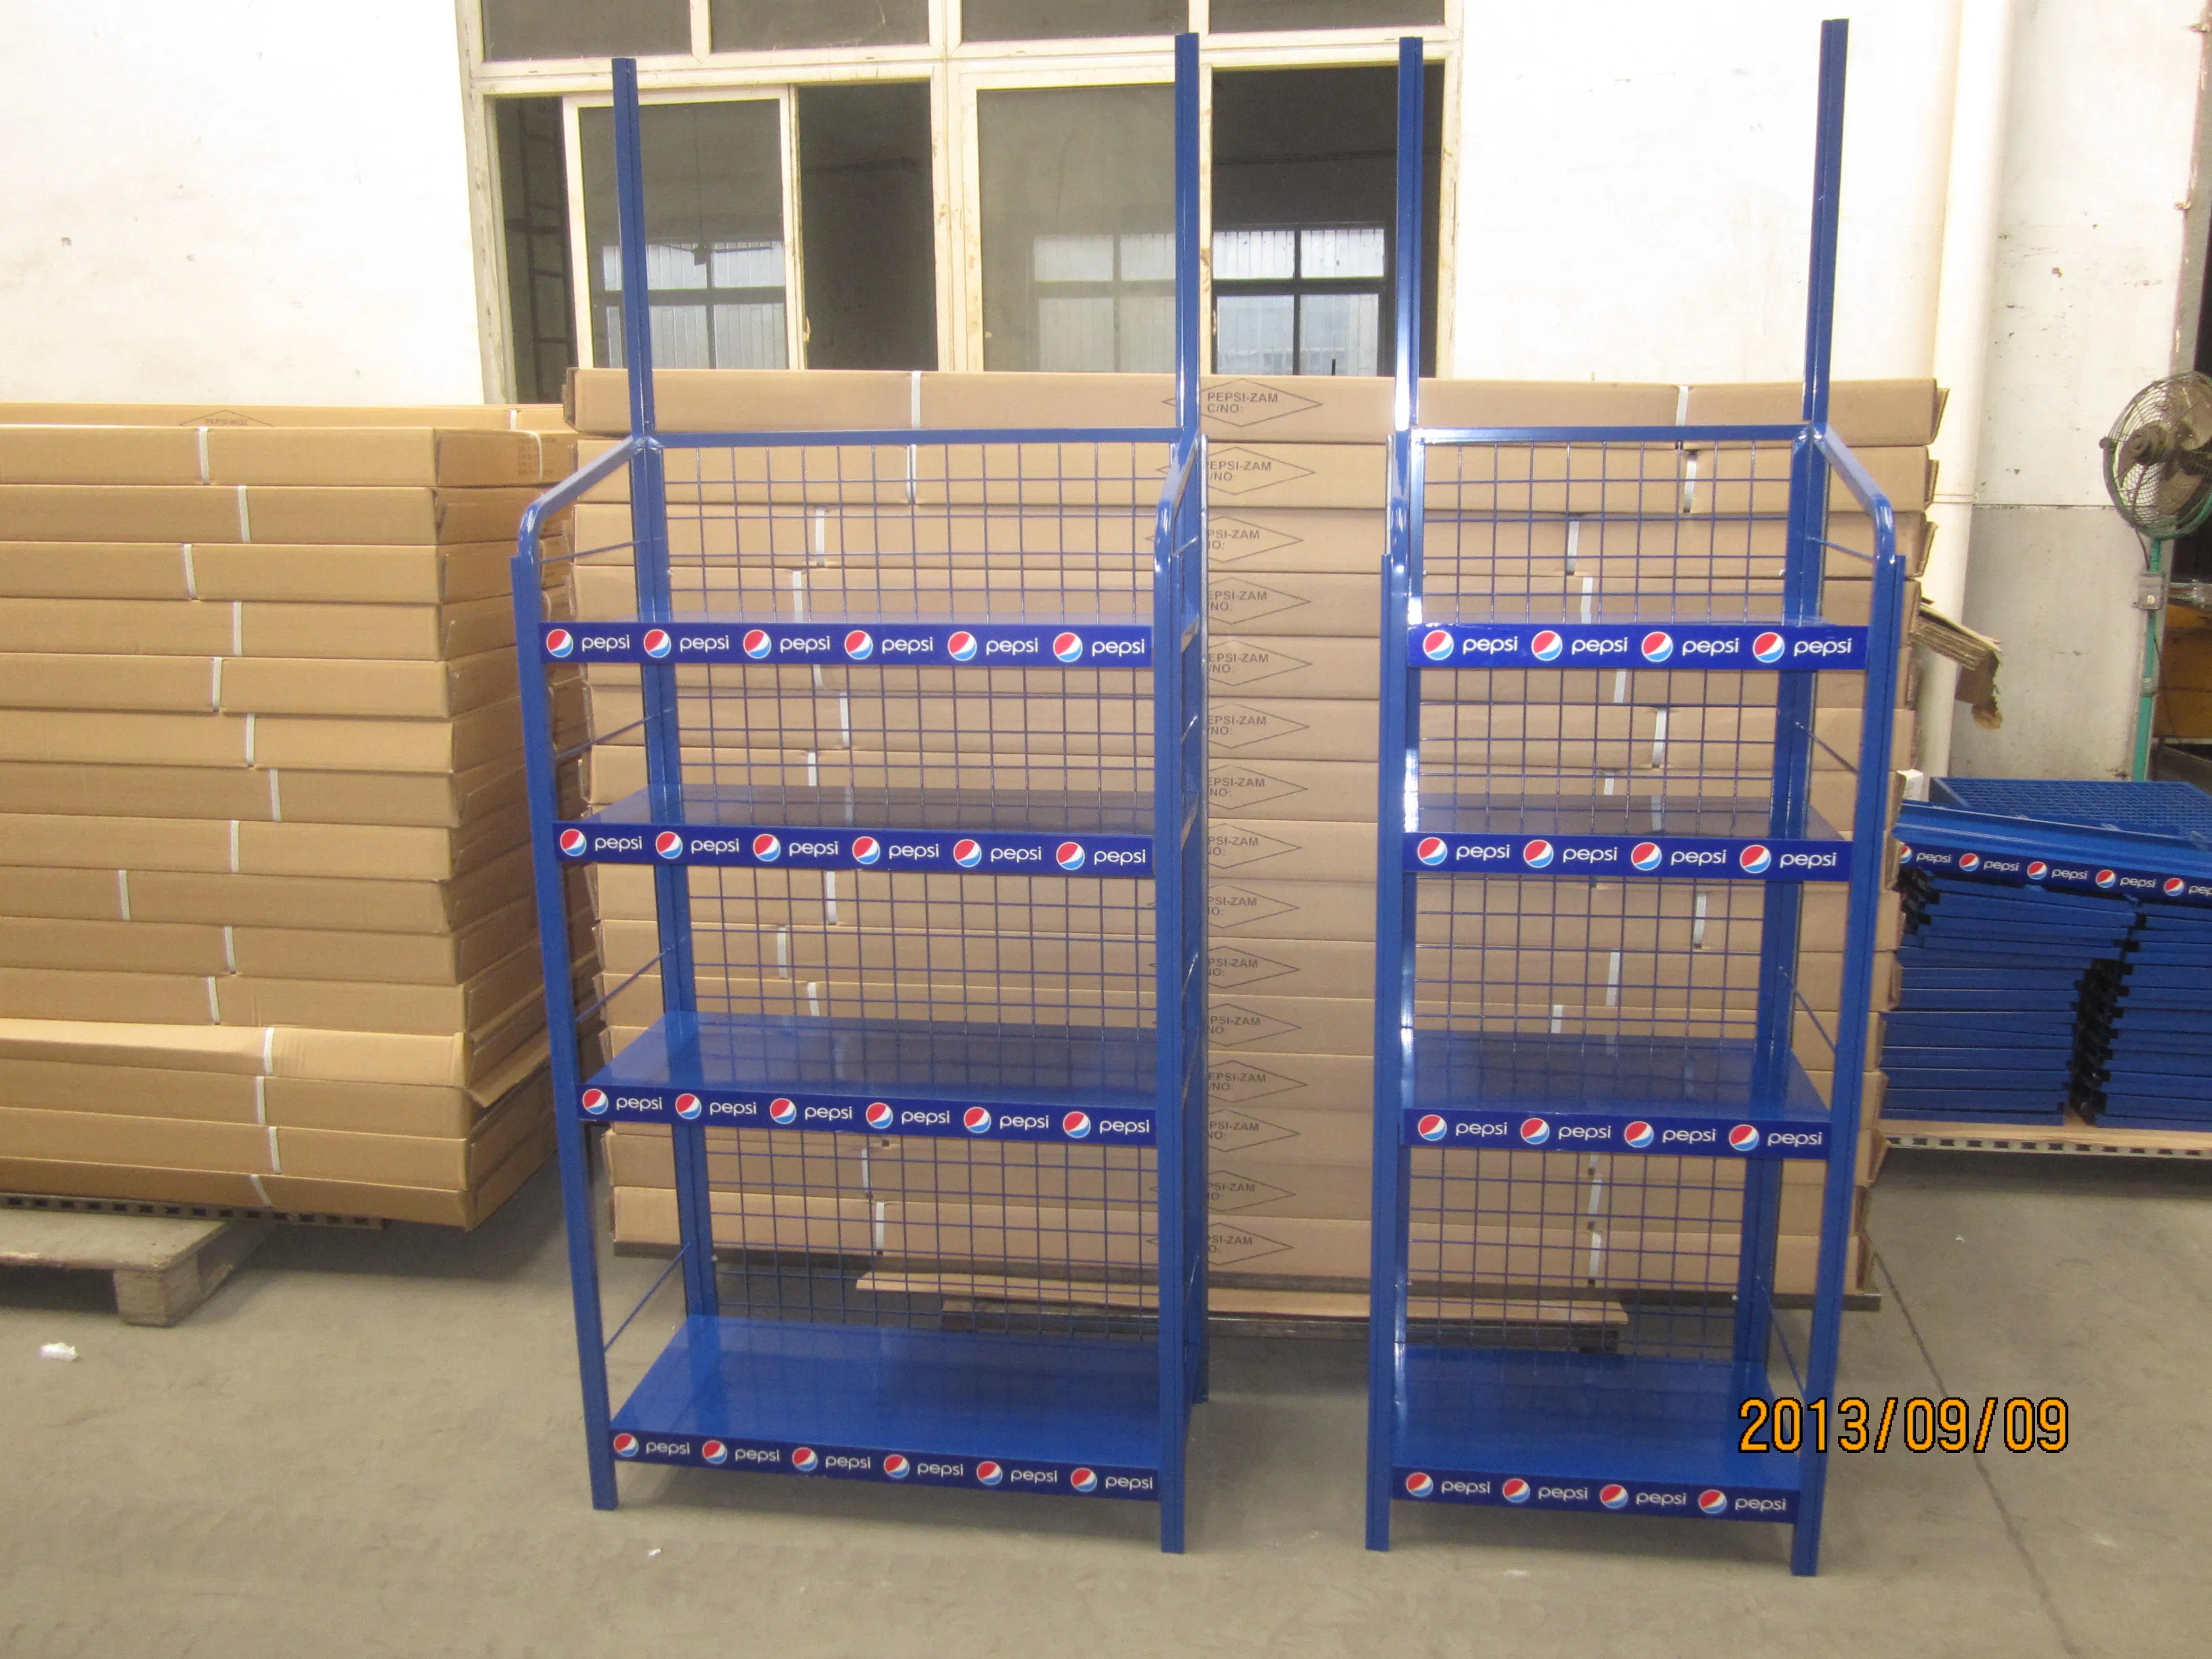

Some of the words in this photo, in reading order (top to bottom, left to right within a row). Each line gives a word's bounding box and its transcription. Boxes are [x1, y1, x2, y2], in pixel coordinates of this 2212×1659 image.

[1208, 392, 1278, 403] PEPSI-ZAM
[1207, 404, 1243, 413] C/NO:
[1208, 461, 1271, 471] EPSI-ZAM
[1210, 472, 1236, 481] /NO:
[1208, 530, 1260, 539] PSI-ZAM
[1208, 591, 1267, 600] EPSI-ZAM
[581, 634, 630, 652] pepsi
[679, 634, 729, 653] pepsi
[779, 635, 831, 654] pepsi
[882, 636, 933, 655] pepsi
[985, 637, 1039, 656] pepsi
[1091, 638, 1145, 657] pepsi
[1462, 636, 1518, 655] pepsi
[1571, 636, 1629, 655] pepsi
[1681, 637, 1740, 657] pepsi
[1793, 638, 1852, 657] pepsi
[1208, 653, 1269, 663] EPSI-ZAM
[1208, 716, 1267, 725] EPSI-ZAM
[1208, 778, 1265, 787] EPSI-ZAM
[1208, 837, 1258, 846] PSI-ZAM
[594, 836, 642, 853] pepsi
[691, 838, 740, 855] pepsi
[788, 840, 839, 857] pepsi
[888, 843, 939, 861] pepsi
[990, 846, 1042, 863] pepsi
[1094, 848, 1146, 866] pepsi
[1456, 844, 1511, 861] pepsi
[1562, 846, 1618, 864] pepsi
[1671, 849, 1727, 867] pepsi
[1780, 852, 1837, 869] pepsi
[1915, 852, 1952, 864] pepsi
[1983, 860, 2020, 872] pepsi
[2051, 869, 2088, 880] pepsi
[2119, 877, 2156, 888] pepsi
[2188, 885, 2212, 897] pep
[1208, 897, 1257, 905] PSI-ZAM
[1208, 958, 1258, 968] PSI-ZAM
[1210, 1016, 1261, 1025] PSI-ZAM
[1209, 1073, 1266, 1082] EPSI-ZAM
[616, 1097, 663, 1112] pepsi
[710, 1101, 757, 1117] pepsi
[804, 1106, 853, 1122] pepsi
[901, 1110, 950, 1126] pepsi
[999, 1115, 1049, 1131] pepsi
[1099, 1119, 1150, 1135] pepsi
[1210, 1121, 1259, 1131] PSI-ZAM
[1455, 1122, 1508, 1137] pepsi
[1558, 1125, 1612, 1141] pepsi
[1662, 1128, 1717, 1145] pepsi
[1767, 1132, 1822, 1147] pepsi
[645, 1441, 691, 1456] pepsi
[735, 1448, 780, 1463] pepsi
[825, 1456, 871, 1471] pepsi
[917, 1462, 964, 1477] pepsi
[1010, 1469, 1058, 1484] pepsi
[1105, 1476, 1153, 1491] pepsi
[1441, 1480, 1491, 1495] pepsi
[1538, 1486, 1589, 1501] pepsi
[1635, 1492, 1687, 1507] pepsi
[1734, 1498, 1786, 1512] pepsi
